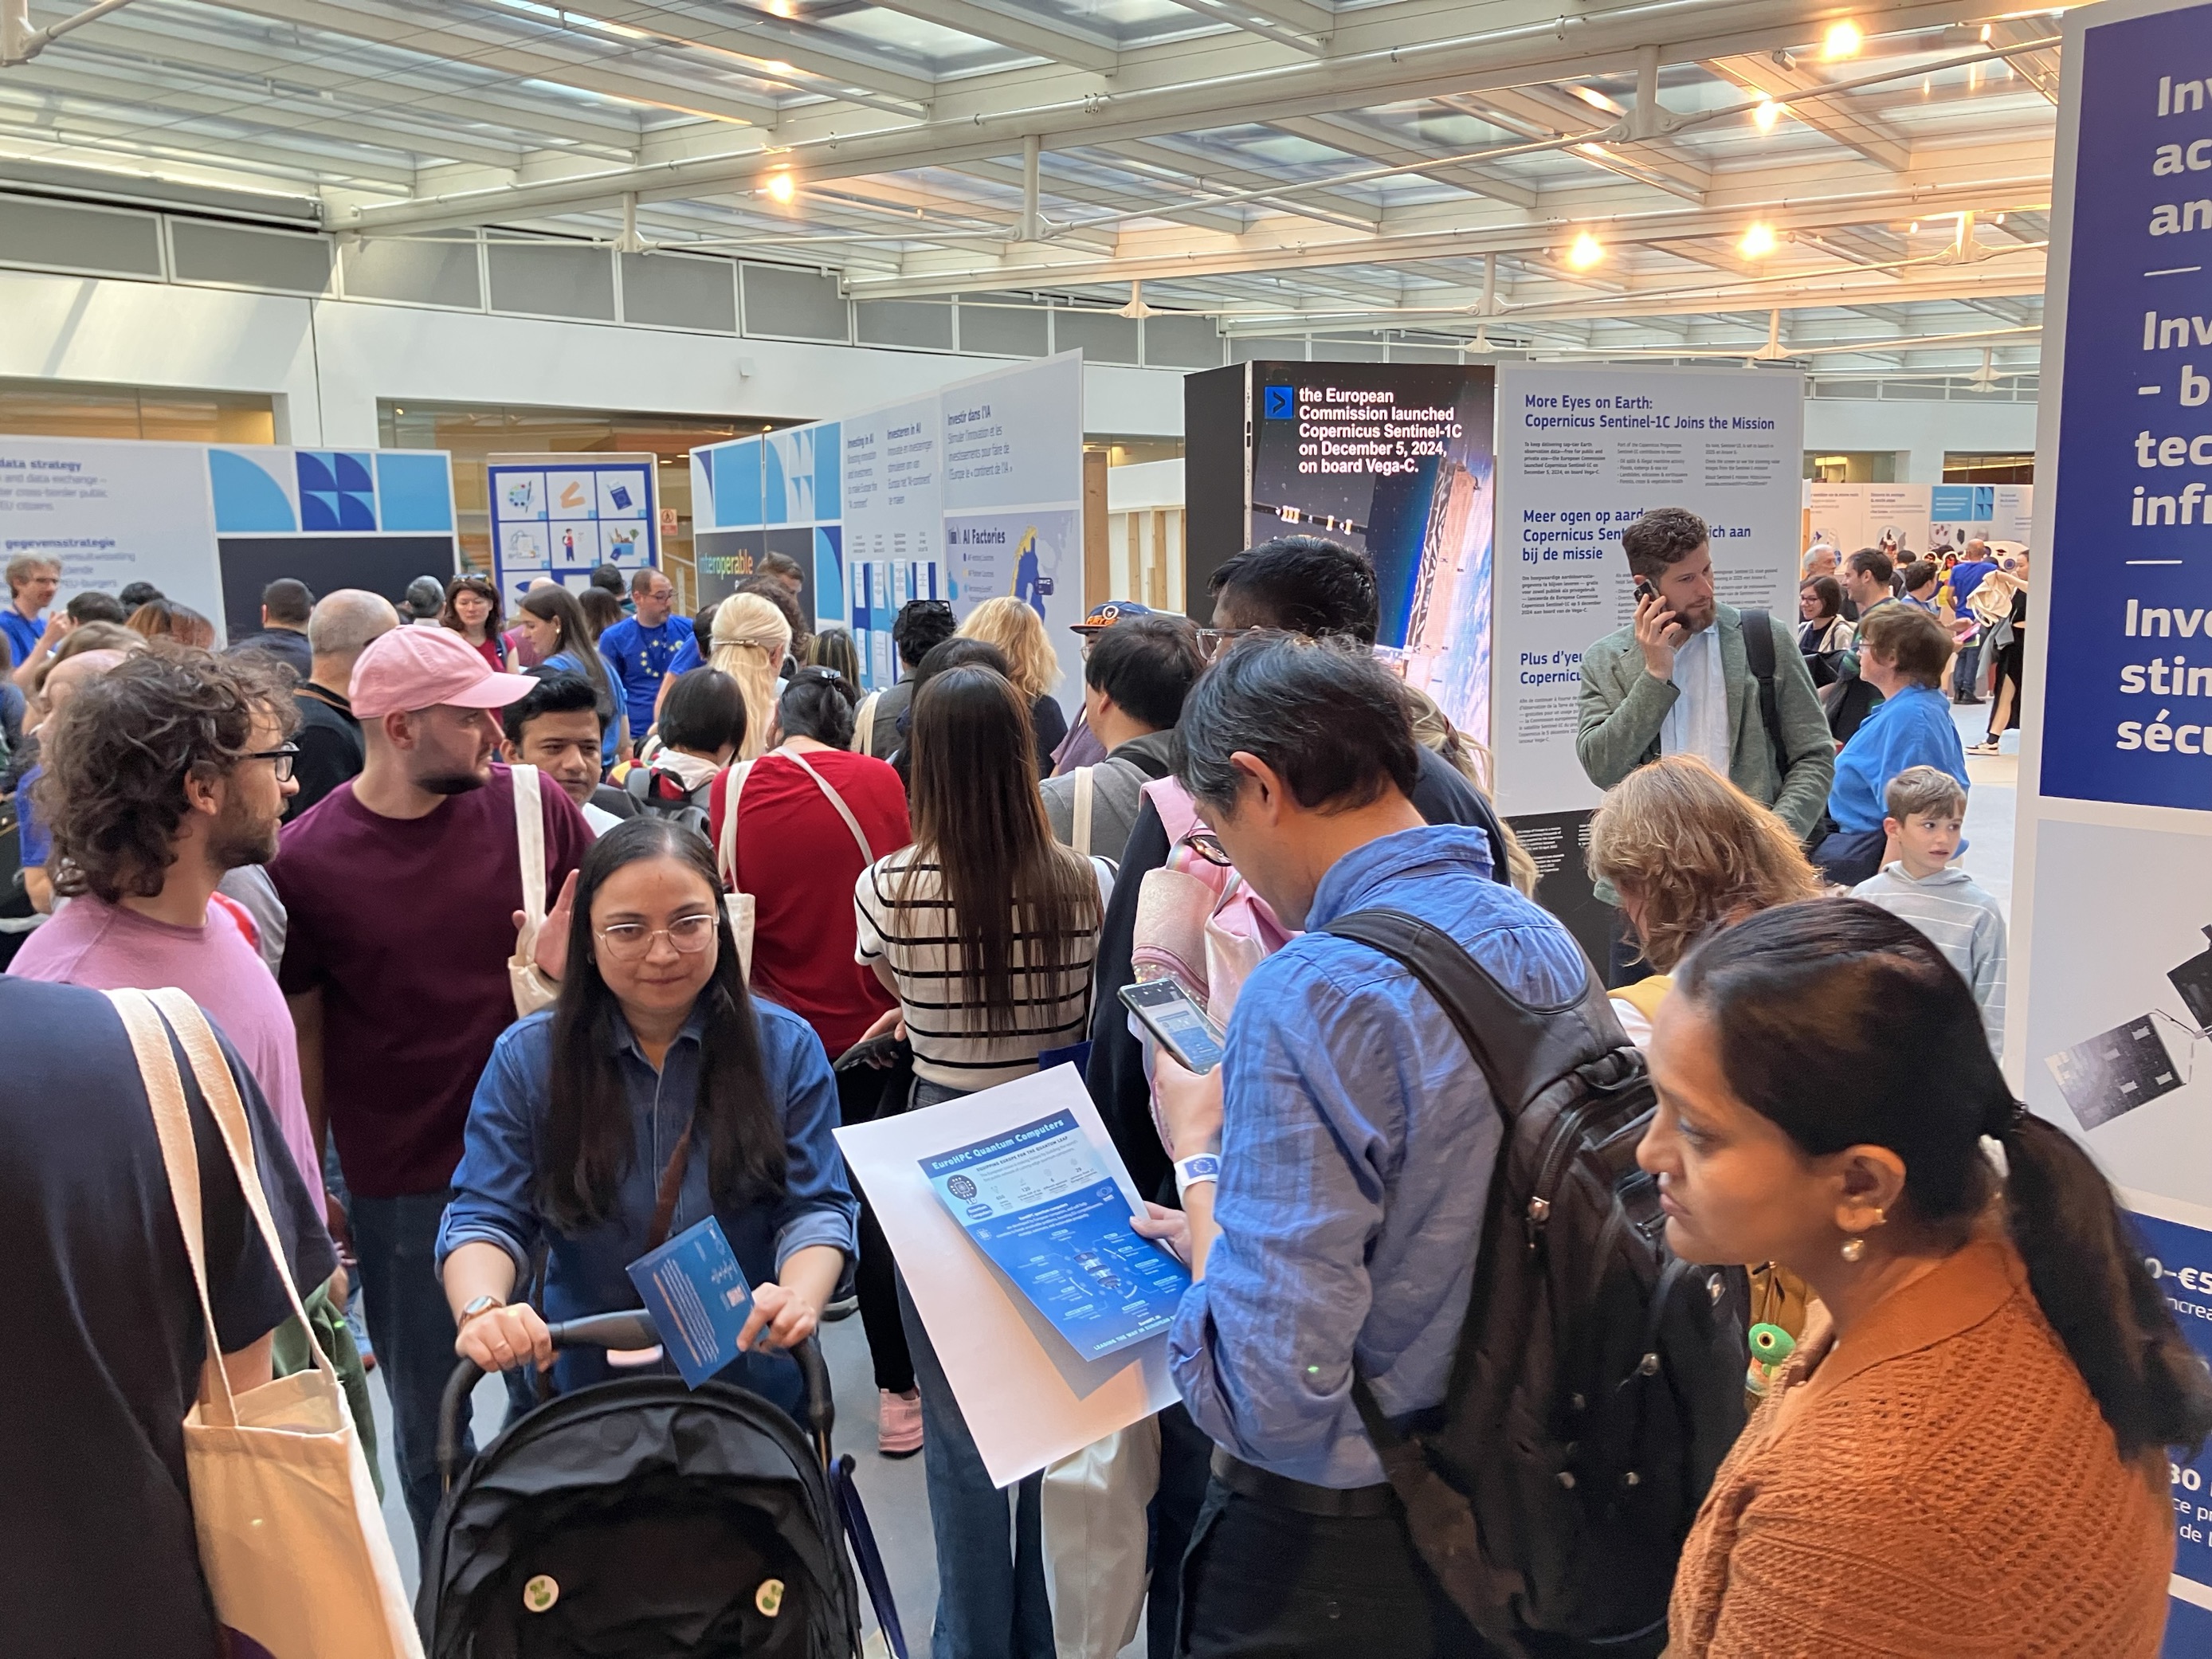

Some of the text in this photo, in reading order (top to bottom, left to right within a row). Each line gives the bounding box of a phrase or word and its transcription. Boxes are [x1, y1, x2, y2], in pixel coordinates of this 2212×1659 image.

[1299, 387, 1394, 406] the European
[1525, 394, 1653, 412] More Eyes on Earth:
[947, 410, 967, 426] Investir
[967, 408, 980, 422] dans
[1299, 406, 1454, 421] Commission launched
[1525, 414, 1775, 430] Copernicus Sentinel-1C Joins the Mission
[887, 422, 921, 440] Investeren in AI
[1299, 423, 1462, 441] Copernicus Sentinel-1C
[847, 436, 865, 449] Investing
[865, 434, 869, 445] in
[1299, 441, 1447, 457] on December 5, 2024,
[30, 460, 82, 472] strategy
[1298, 458, 1419, 477] on board Vega-C.
[1524, 508, 1644, 525] Meer ogen op aard
[963, 527, 1006, 544] AI Factories
[1523, 529, 1594, 545] Copernicus
[1708, 525, 1725, 538] ich
[1729, 528, 1751, 538] aan
[698, 548, 753, 580] interoperable
[1522, 547, 1603, 564] bij de missie
[2124, 598, 2212, 637] Inv
[1520, 652, 1547, 665] Plus
[931, 1119, 1065, 1171] EuroHPC Quantum Computers
[976, 1161, 1000, 1172] EQUIPPING
[999, 1155, 1017, 1166] EUROPE
[1017, 1151, 1027, 1159] FOR
[1036, 1141, 1057, 1152] QUANTUM
[1057, 1135, 1069, 1144] LEAP
[1093, 1338, 1116, 1351] LEADING
[2179, 1524, 2202, 1543] de
